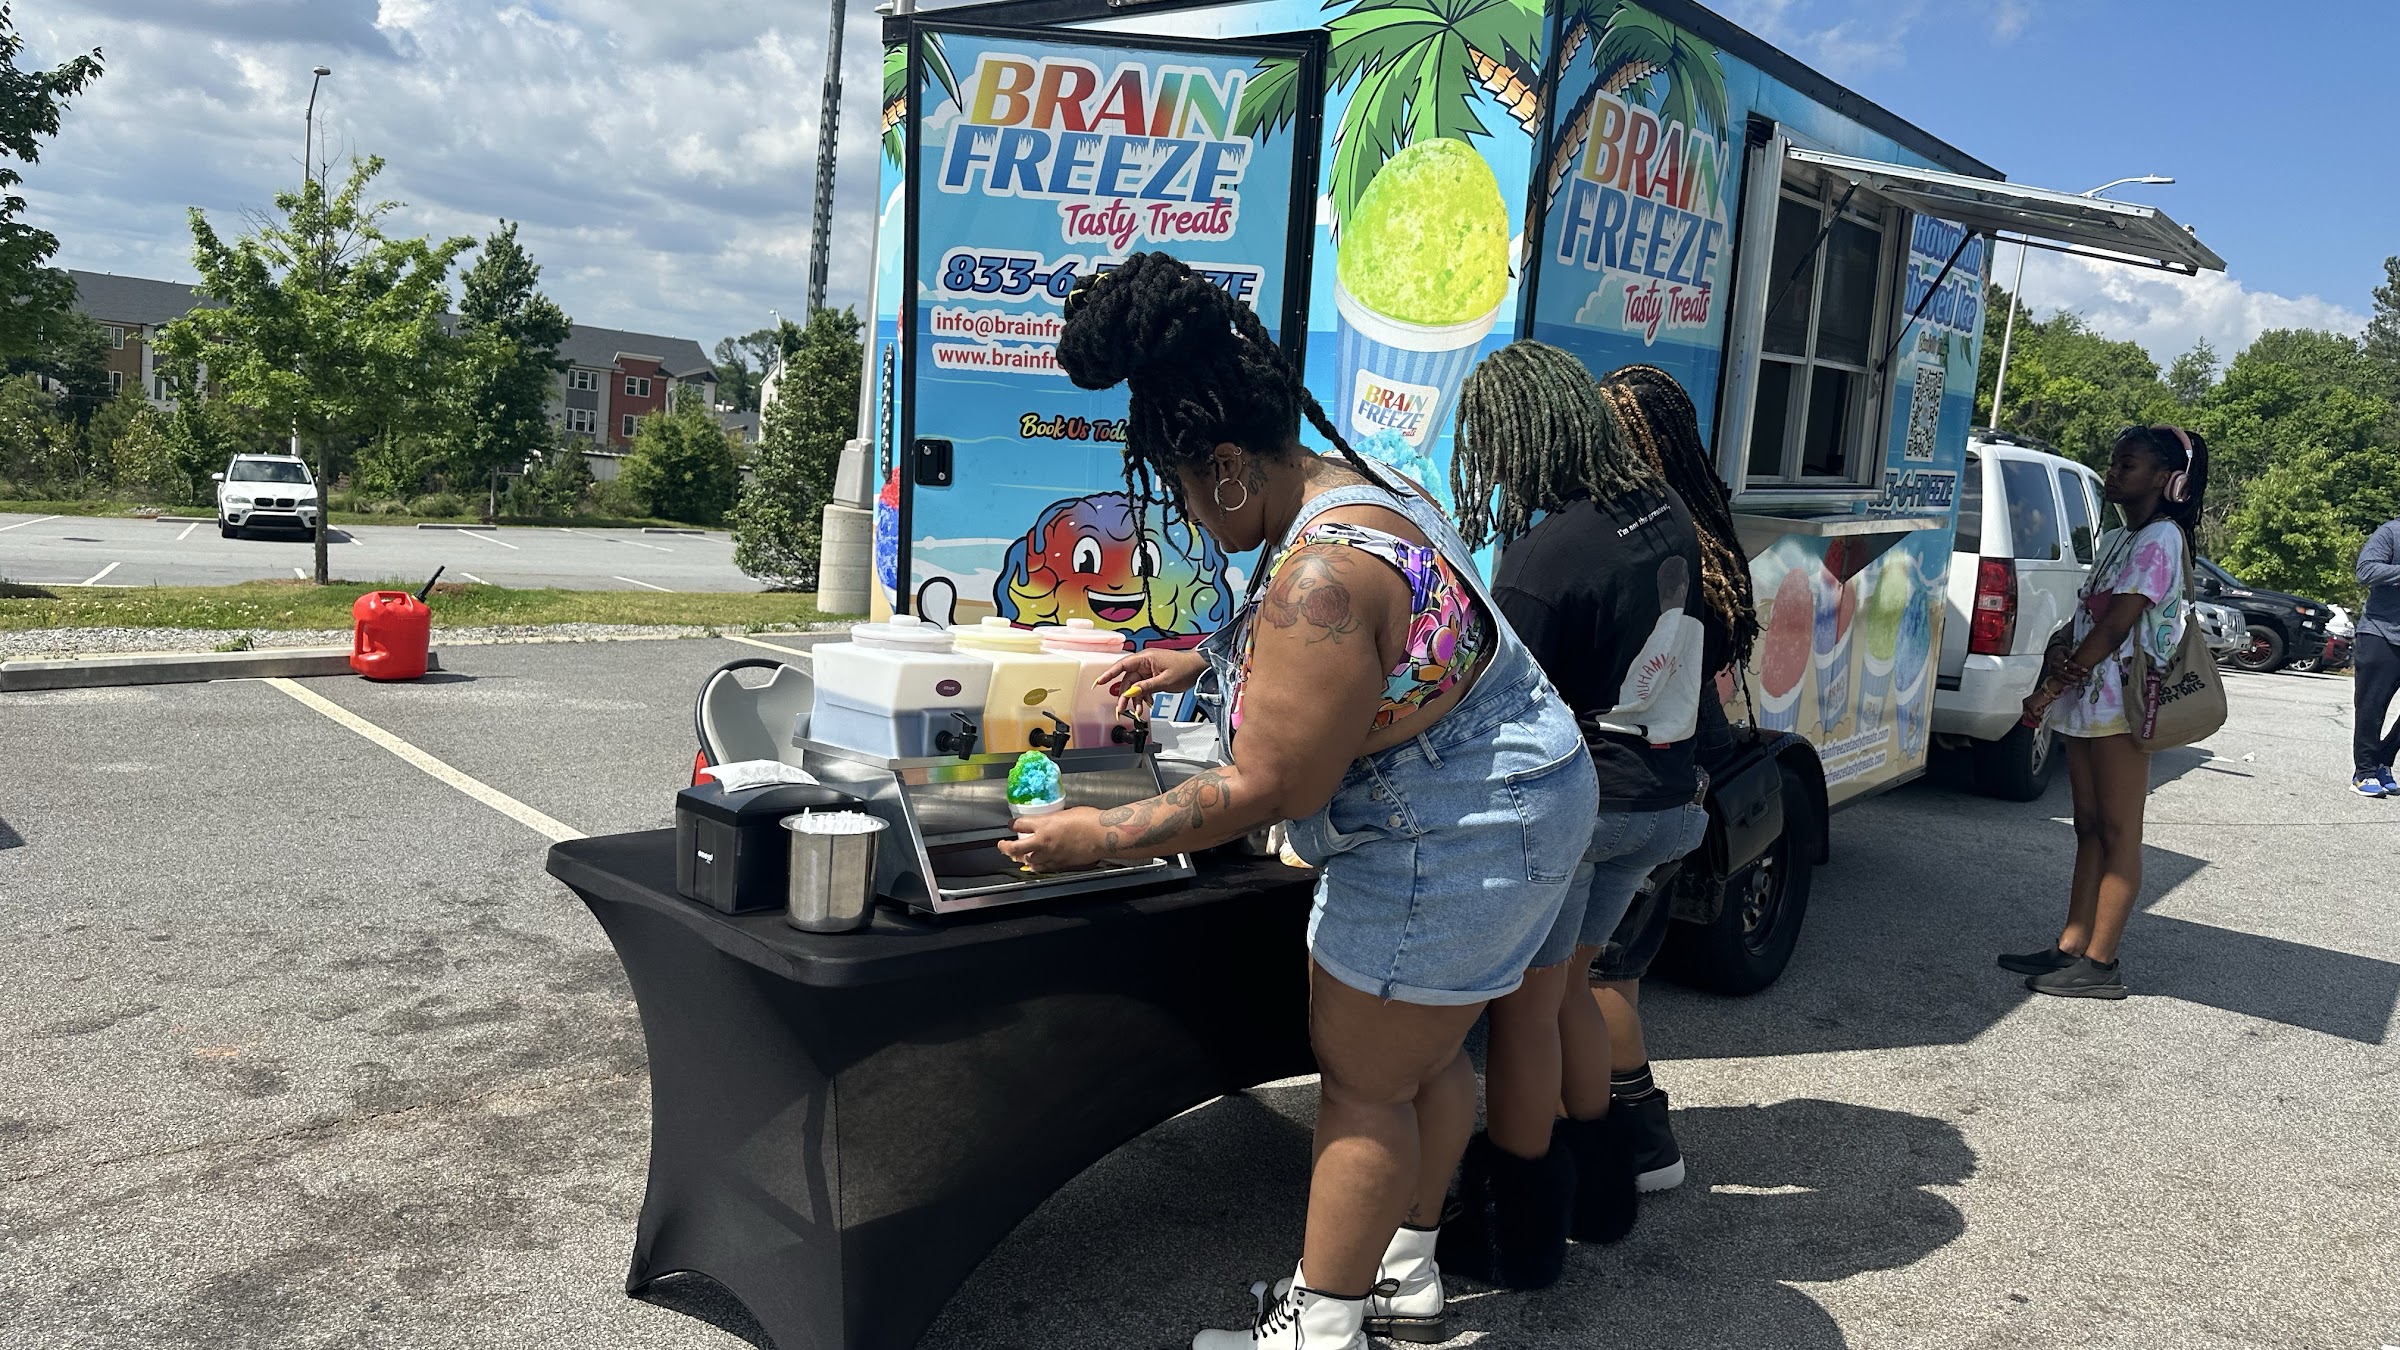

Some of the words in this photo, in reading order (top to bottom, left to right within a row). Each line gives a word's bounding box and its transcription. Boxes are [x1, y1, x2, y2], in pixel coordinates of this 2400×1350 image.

[970, 58, 1239, 141] BRAIN
[945, 124, 1246, 205] FREEZE
[1583, 97, 1729, 219] BRAIN
[1064, 198, 1139, 250] Tasty
[1148, 197, 1233, 236] Treats
[1560, 178, 1723, 289] FREEZE
[1624, 280, 1664, 340] Tasty
[1667, 281, 1711, 324] Treats
[1955, 285, 1977, 330] Ice
[1357, 400, 1424, 429] FREEZE
[1364, 384, 1429, 413] BRAIN
[1021, 413, 1065, 439] Book
[1067, 417, 1090, 439] Us
[1616, 528, 1630, 538] I'm
[1629, 521, 1639, 531] not
[1638, 516, 1649, 526] the
[2181, 680, 2205, 695] DAYS
